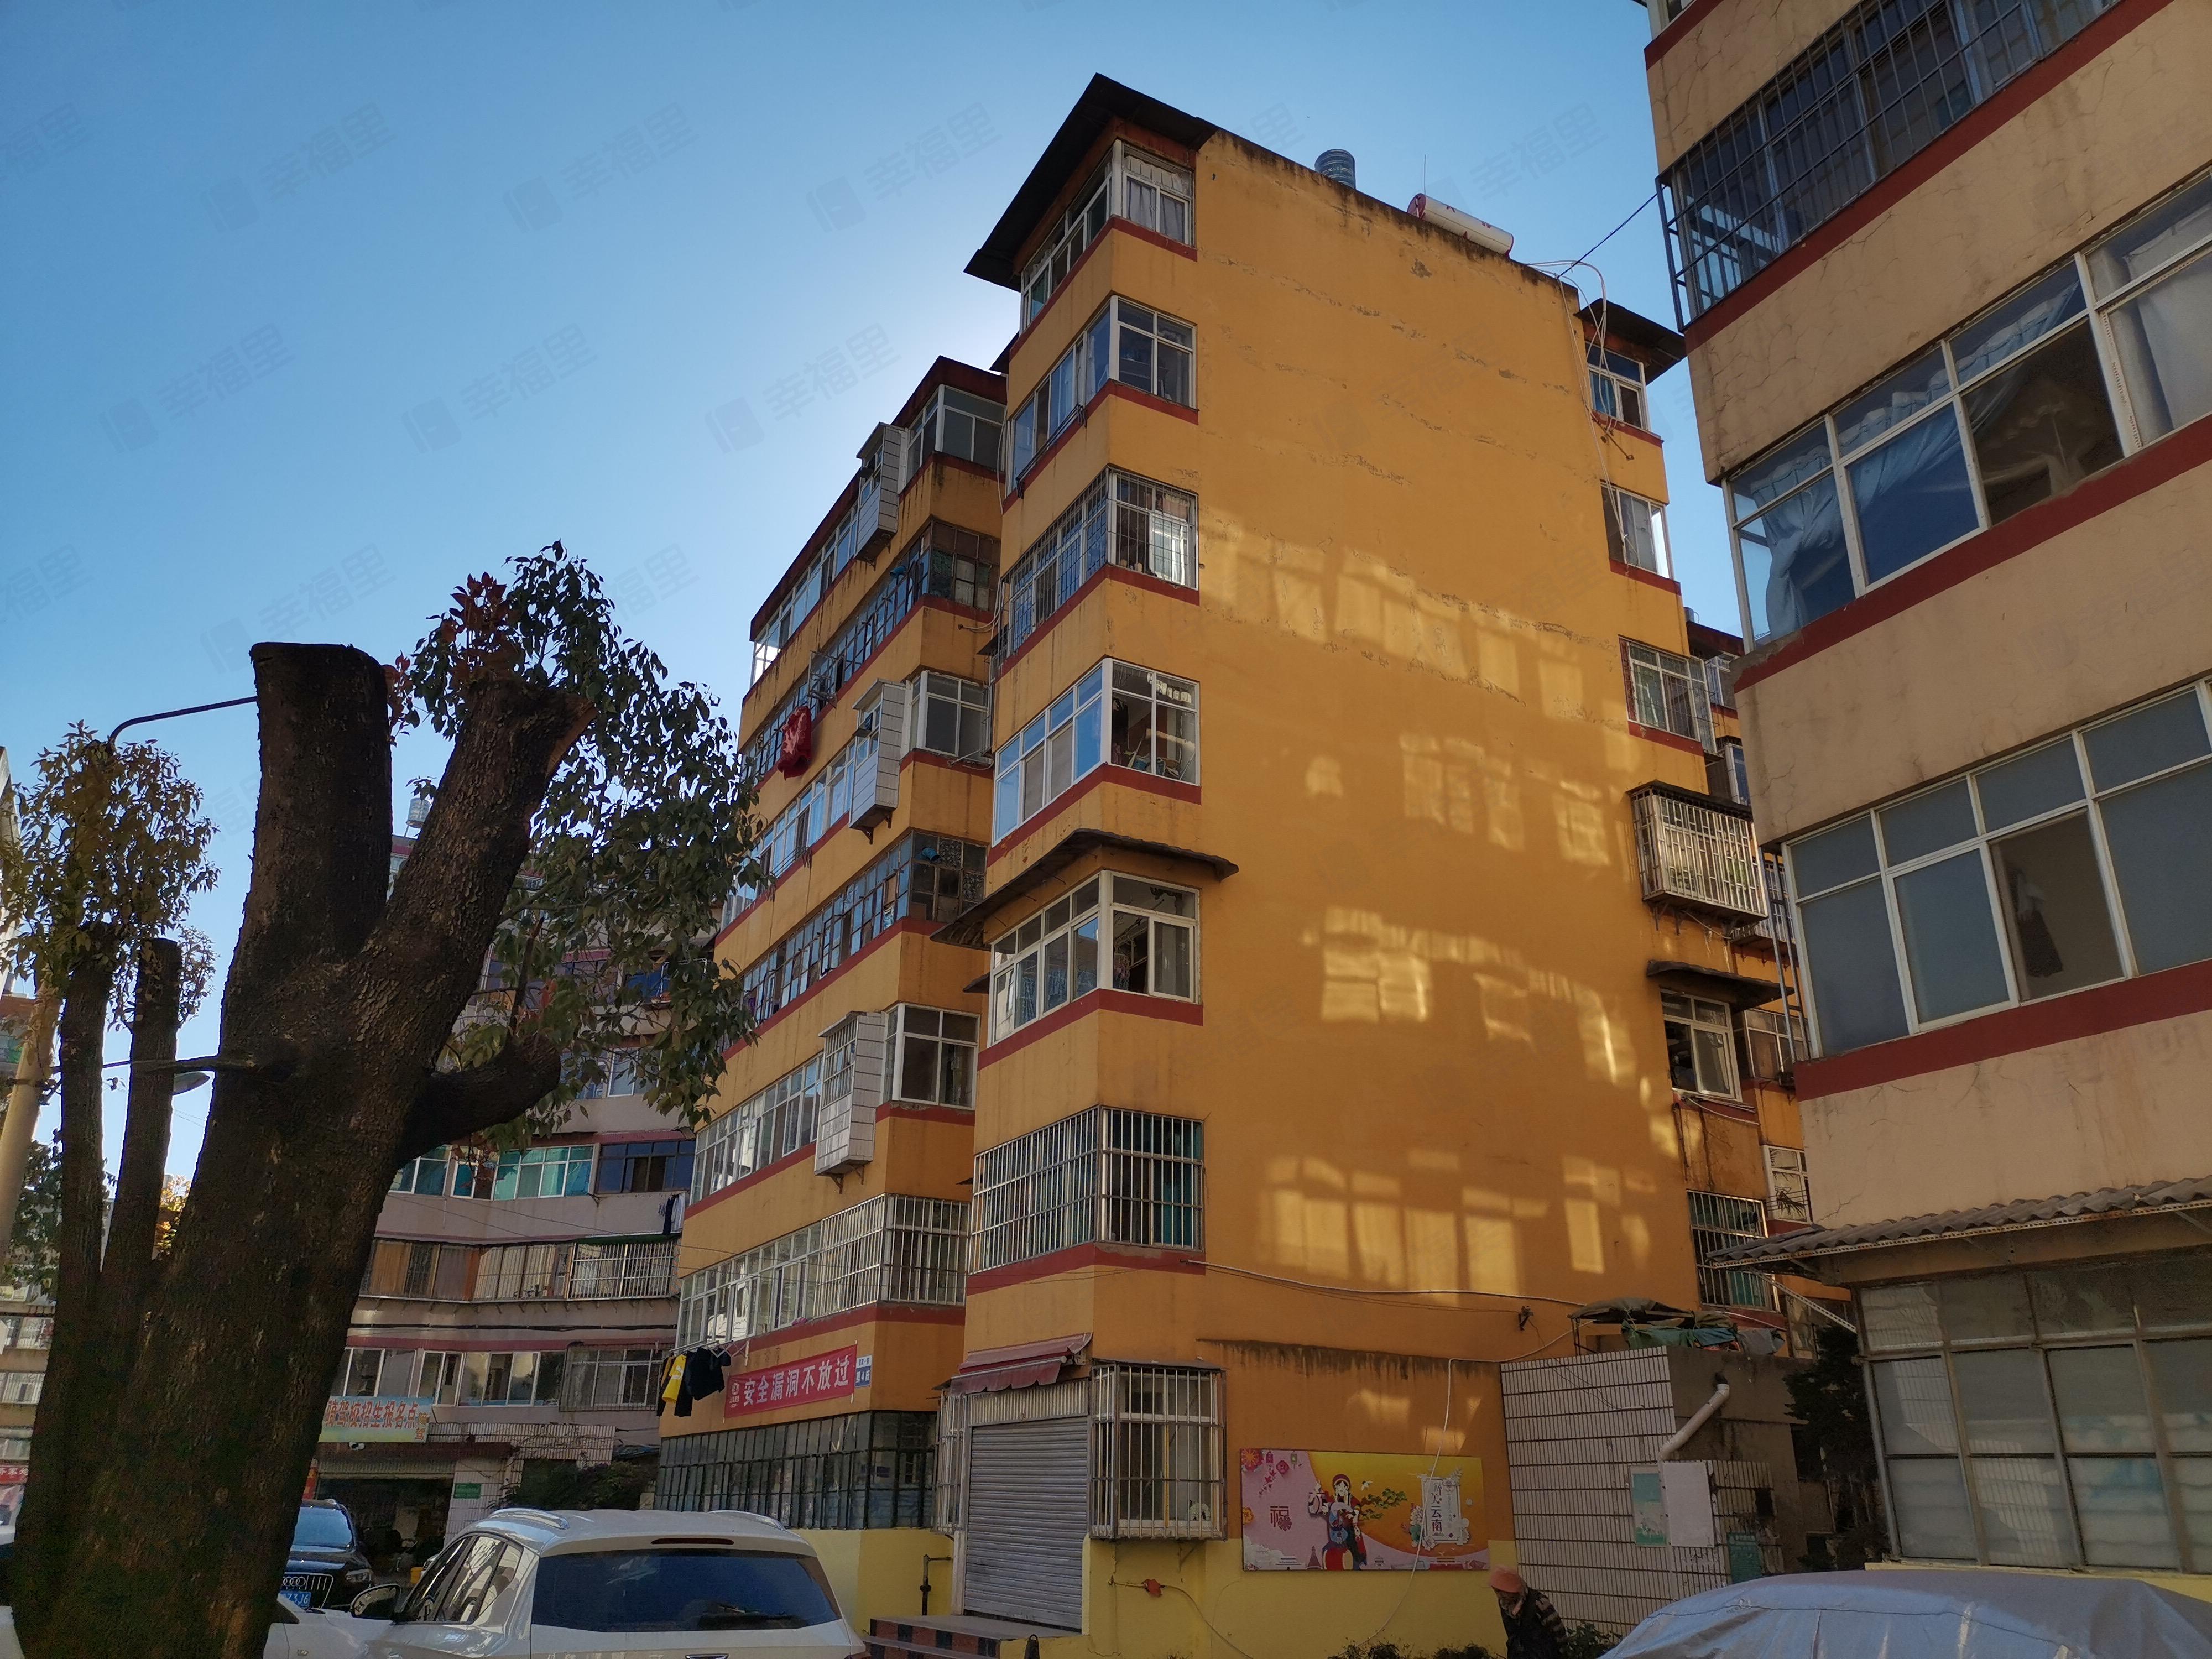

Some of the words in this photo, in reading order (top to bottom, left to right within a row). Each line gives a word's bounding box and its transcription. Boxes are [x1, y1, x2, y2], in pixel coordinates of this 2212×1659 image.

[743, 1355, 850, 1407] 安全漏洞不放过
[1270, 1505, 1292, 1531] 福
